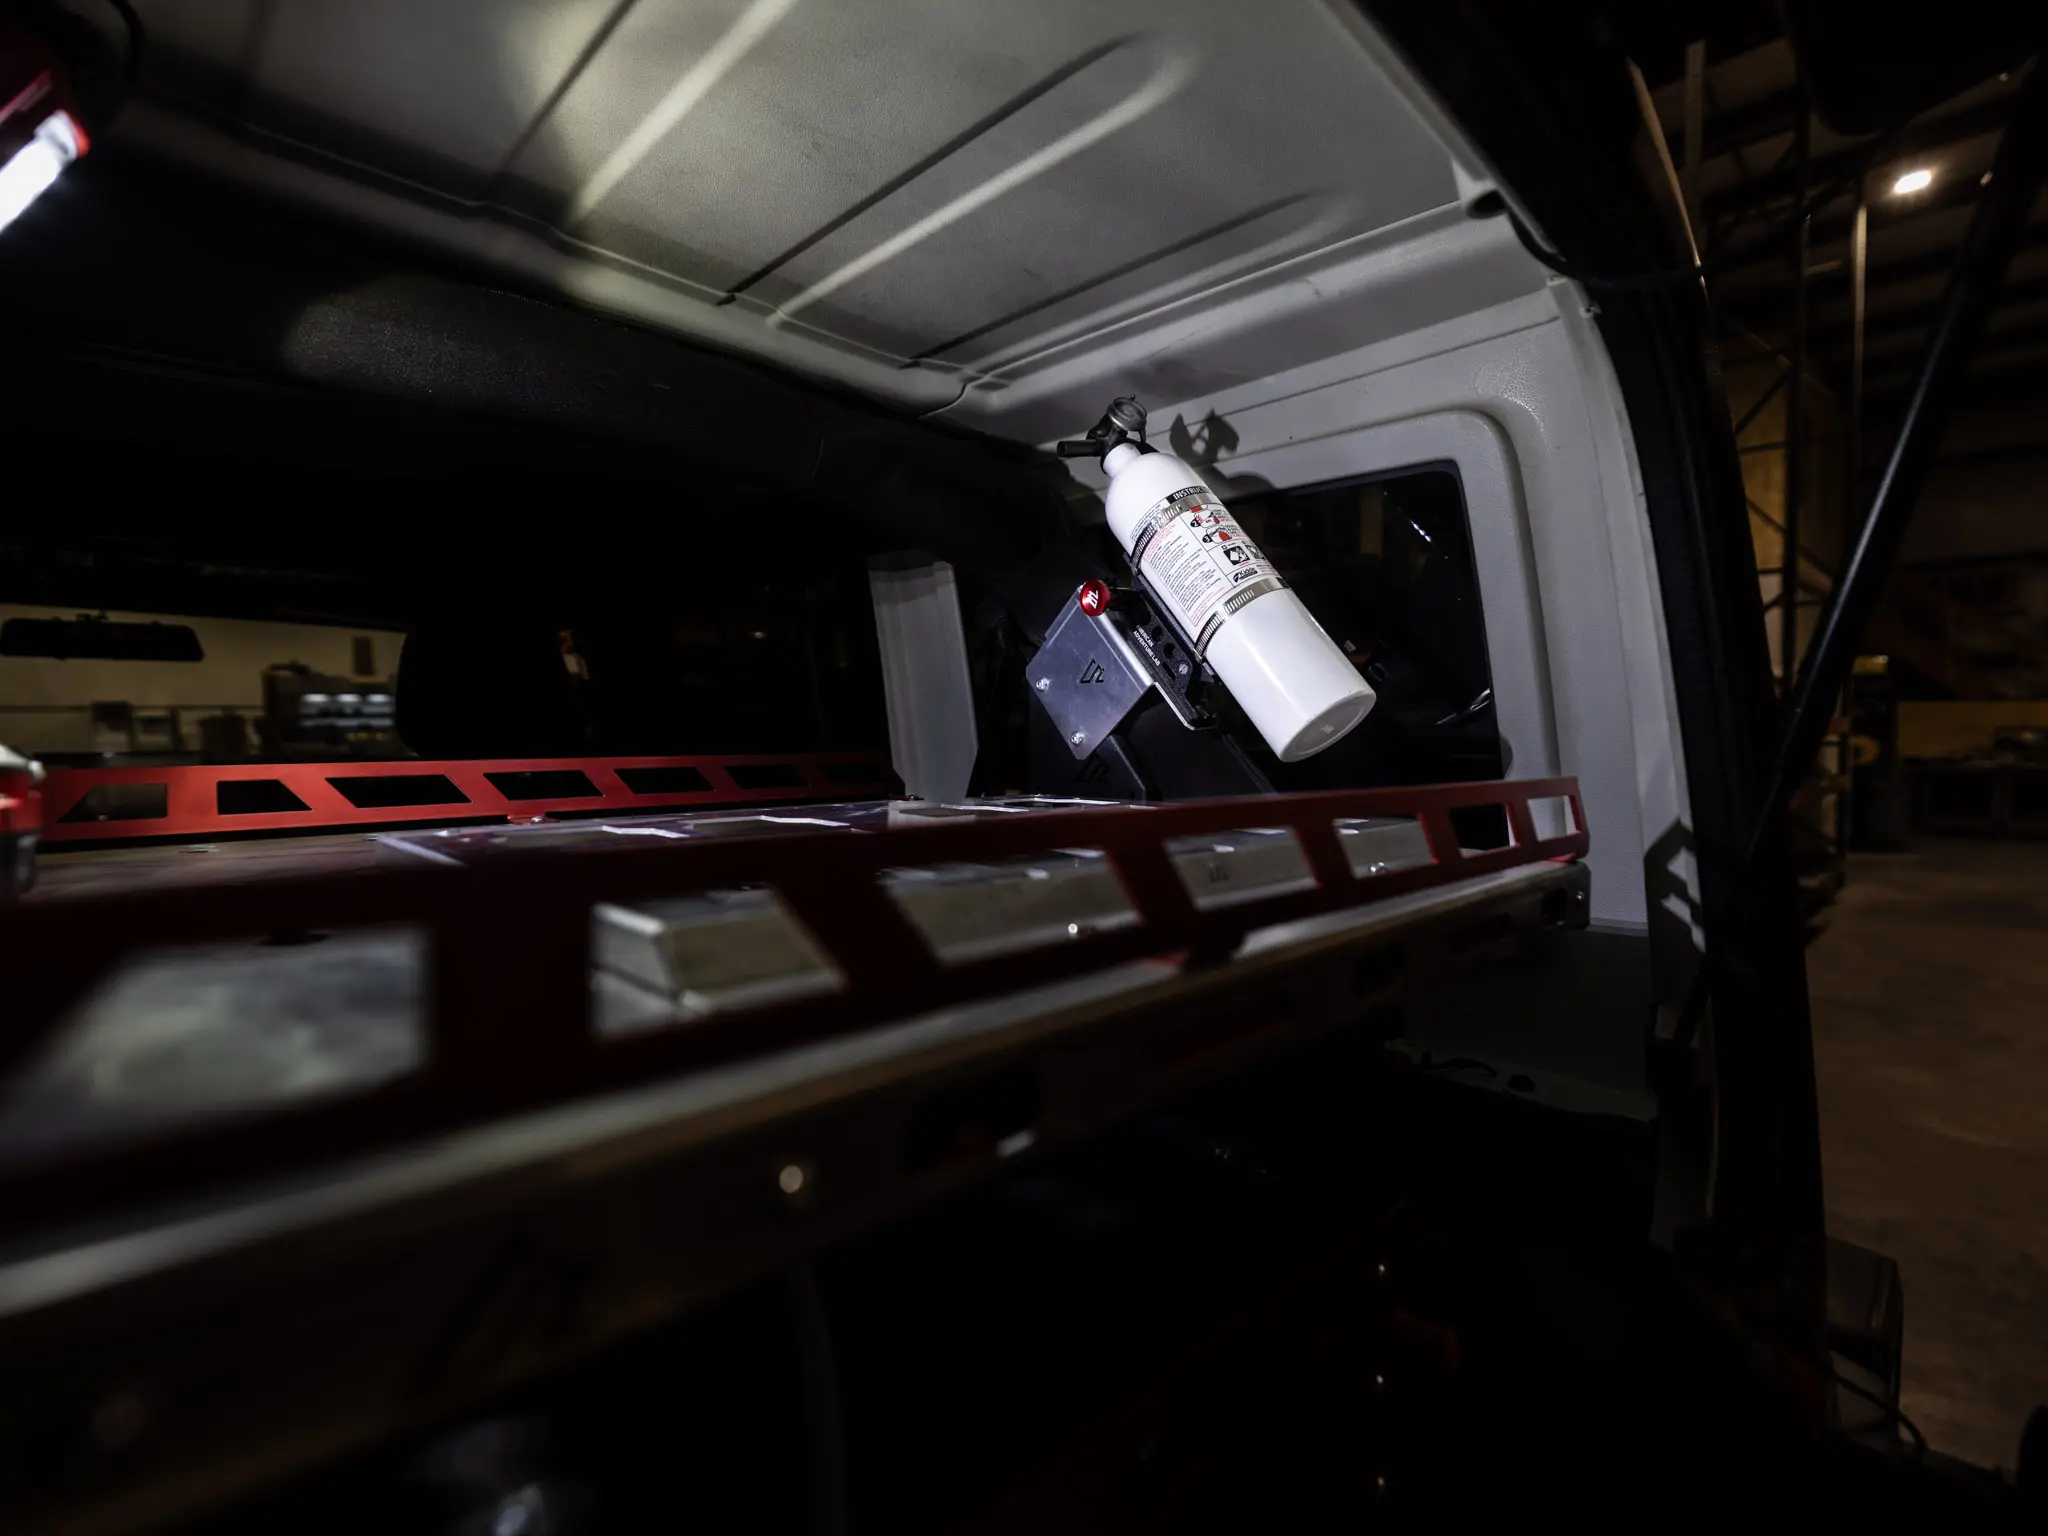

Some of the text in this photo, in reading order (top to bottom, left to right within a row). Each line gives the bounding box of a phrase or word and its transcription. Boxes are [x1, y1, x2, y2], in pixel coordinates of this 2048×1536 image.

[1133, 630, 1161, 666] ADVENTURE LAB
[1136, 624, 1154, 647] AMERICAN
